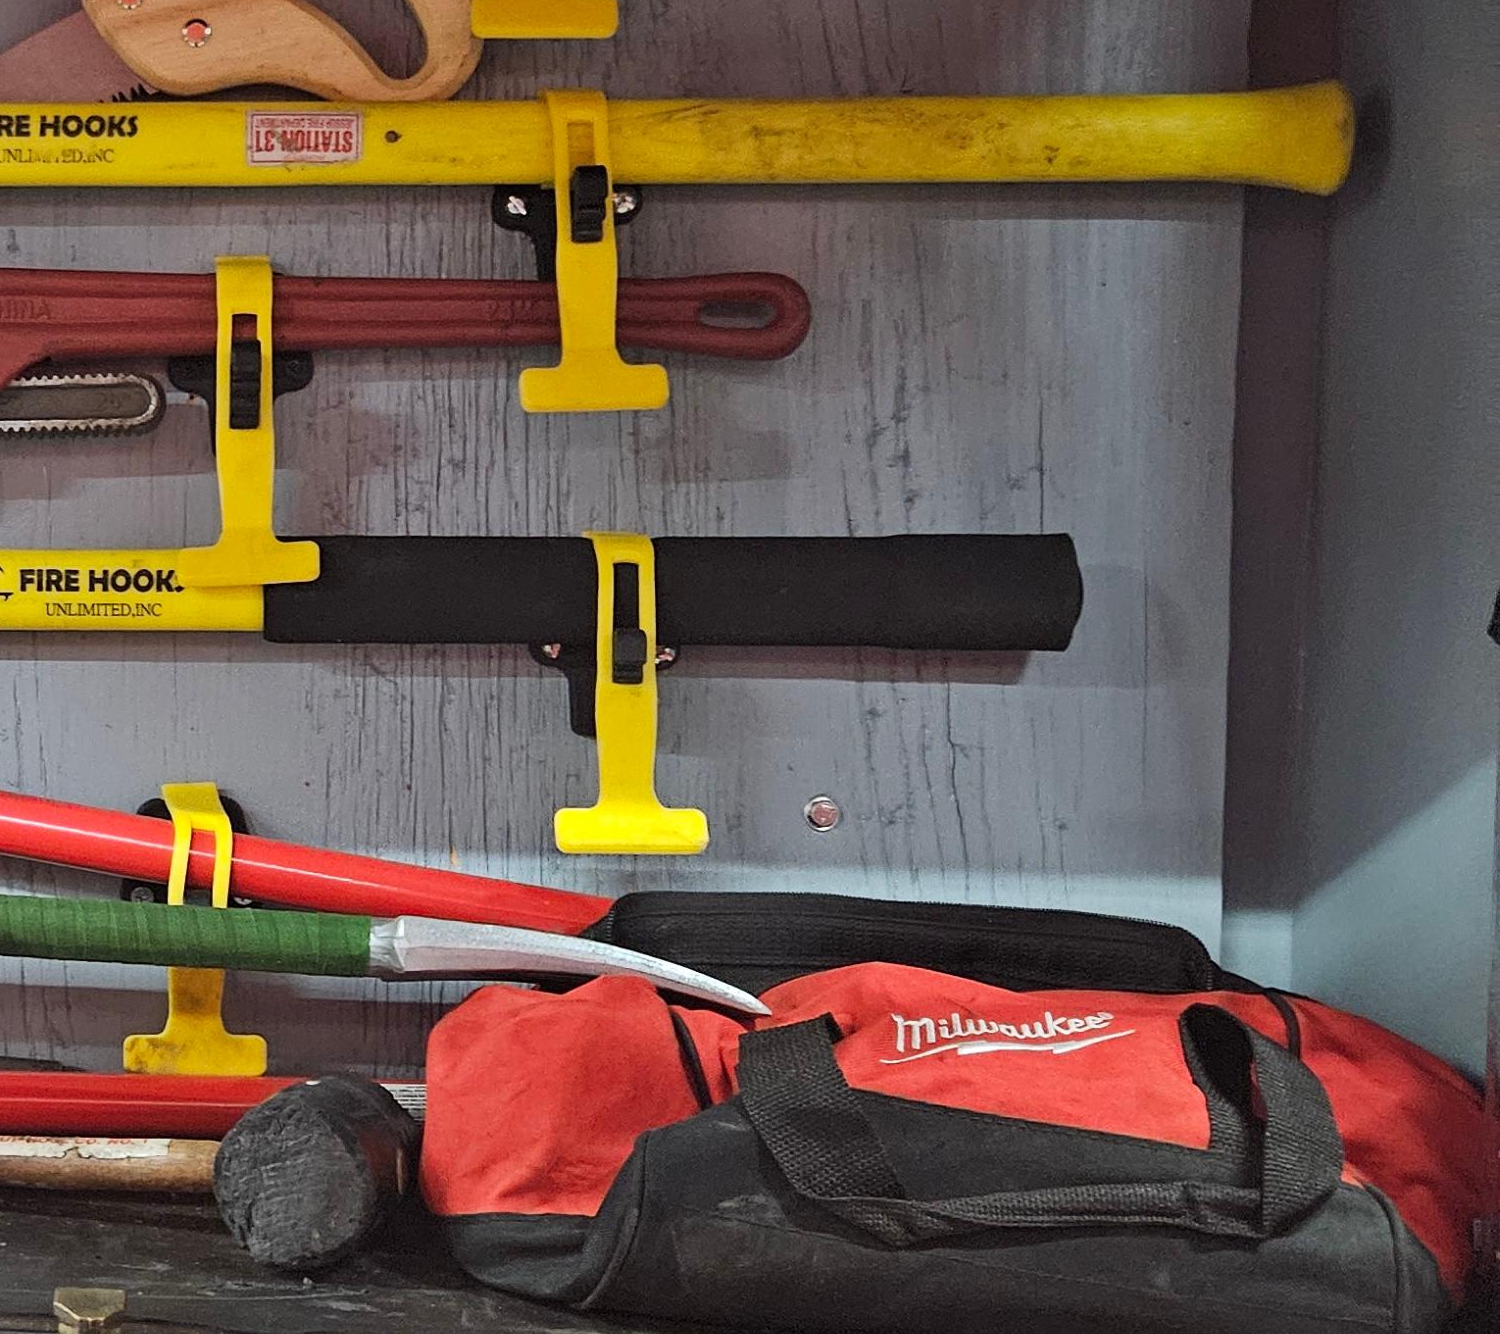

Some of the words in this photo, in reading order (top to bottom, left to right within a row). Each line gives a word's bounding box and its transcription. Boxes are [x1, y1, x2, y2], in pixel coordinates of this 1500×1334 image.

[38, 114, 139, 139] HOOKS
[255, 129, 275, 153] 31
[280, 129, 354, 153] STATION
[19, 568, 80, 593] FIRE
[88, 568, 185, 593] HOOK
[890, 1010, 1114, 1053] Milwaukee
